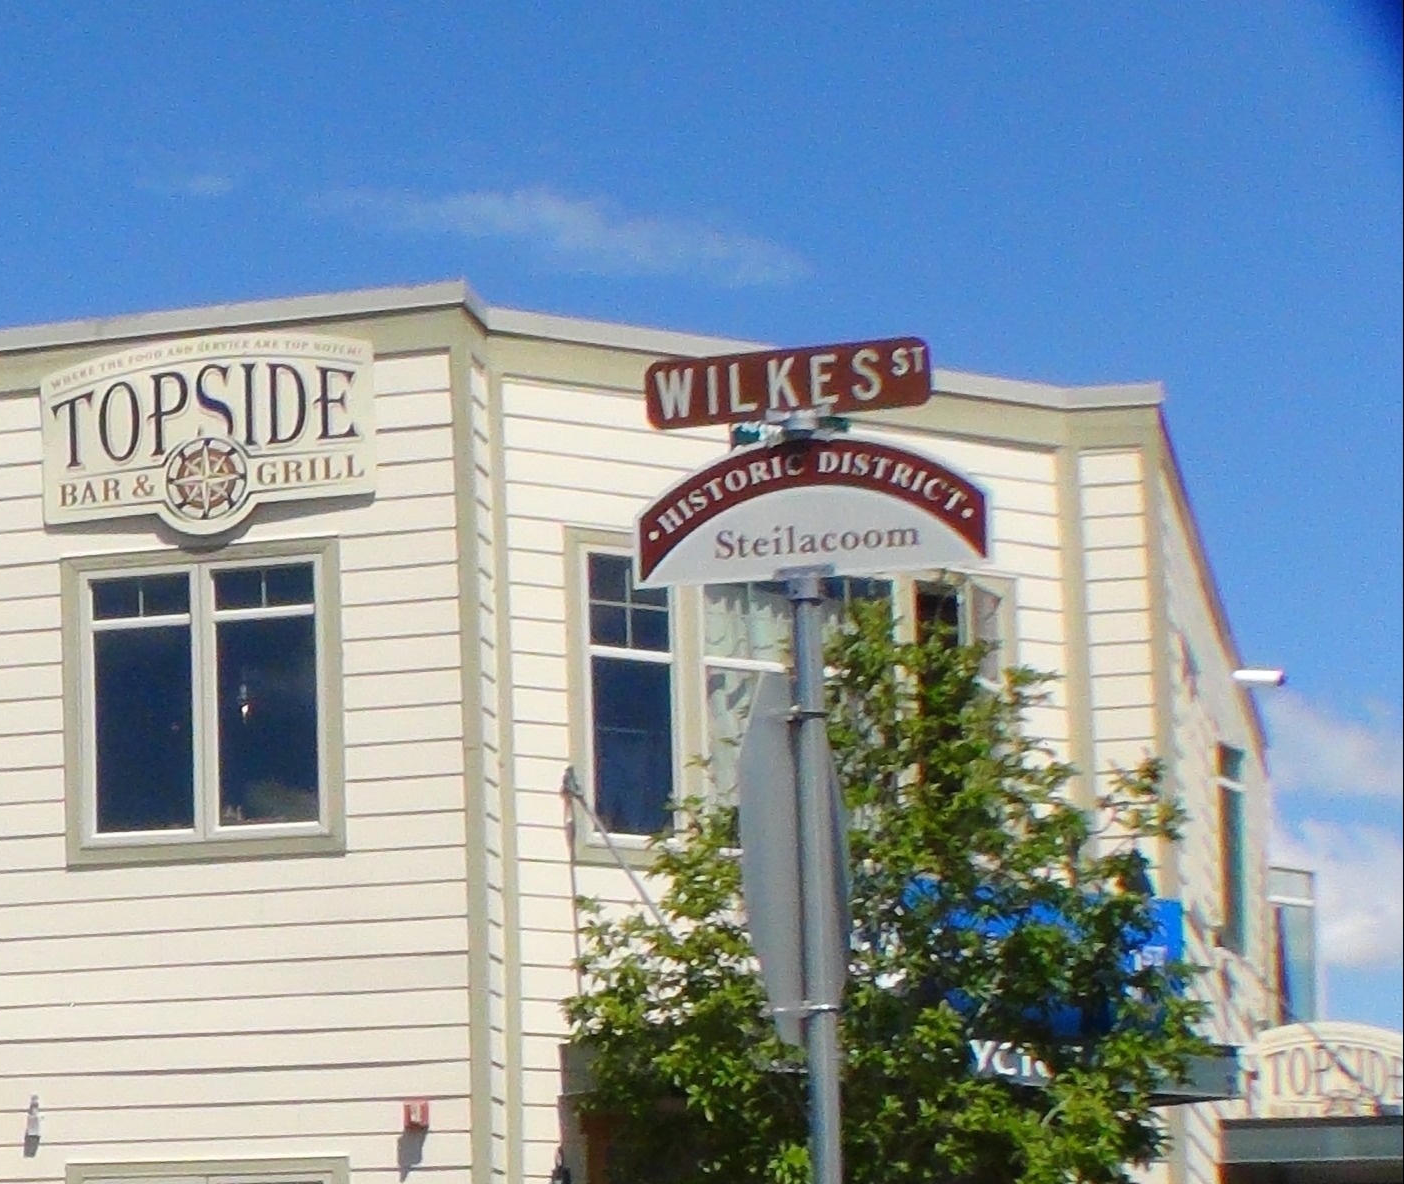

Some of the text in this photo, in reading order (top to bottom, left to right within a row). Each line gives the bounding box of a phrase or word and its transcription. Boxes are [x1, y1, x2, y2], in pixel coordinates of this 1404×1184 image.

[98, 357, 124, 373] THE
[127, 350, 163, 366] FOOD
[654, 345, 925, 421] WILKES ST
[51, 362, 360, 469] TOPSIDE
[59, 454, 365, 508] BAR & GRILL
[656, 450, 969, 535] HISTORIC DISTRICT
[714, 524, 921, 561] Steilacoom
